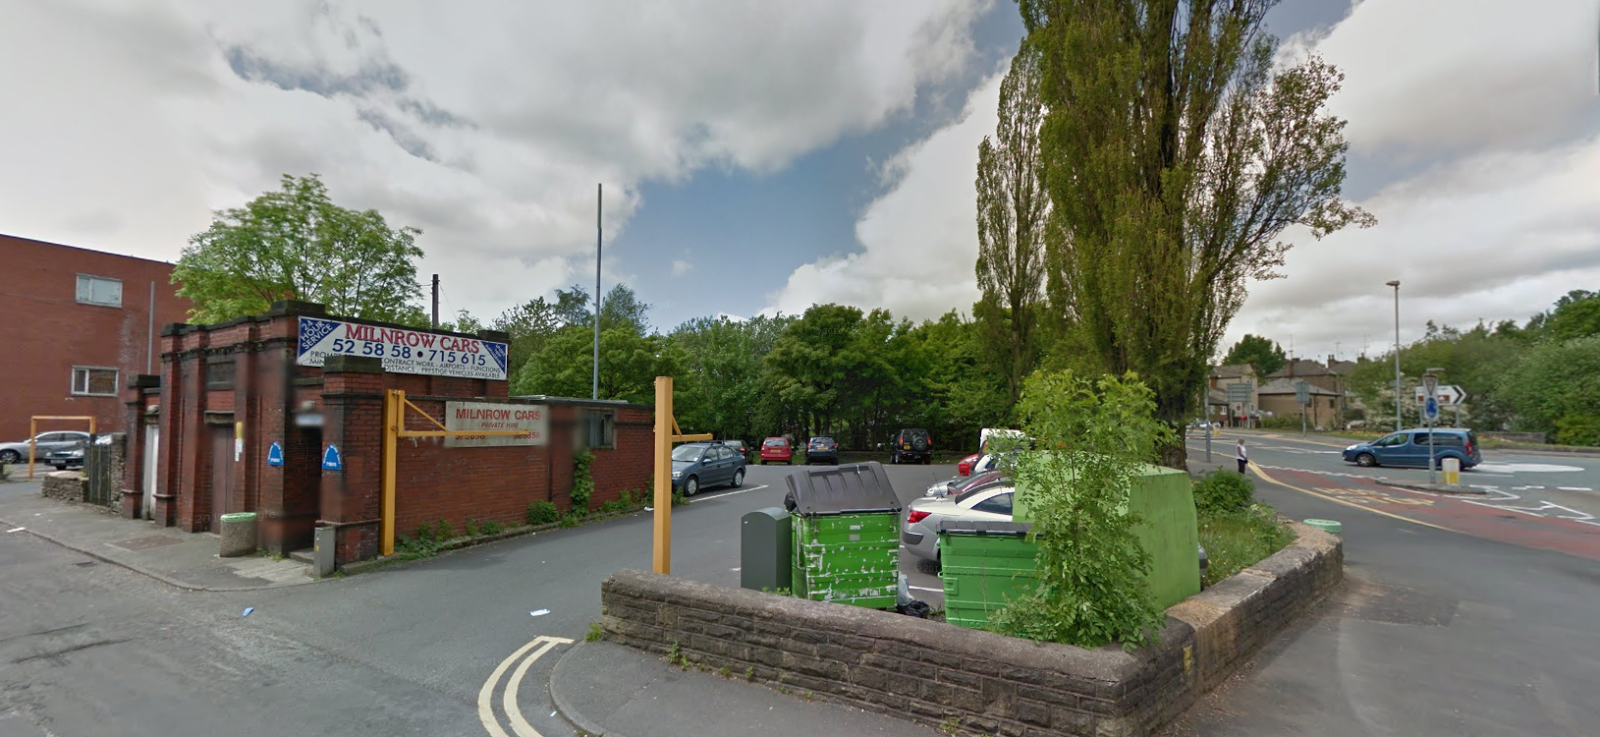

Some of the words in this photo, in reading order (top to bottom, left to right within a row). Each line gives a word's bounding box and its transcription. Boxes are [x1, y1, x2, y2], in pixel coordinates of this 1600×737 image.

[300, 321, 325, 341] HOUR
[301, 320, 314, 330] 24
[301, 323, 333, 350] SERVICE
[345, 323, 437, 348] MILNROW
[439, 335, 480, 354] CARS
[332, 338, 355, 353] 52
[362, 341, 385, 356] 58
[390, 345, 412, 359] 58
[428, 349, 456, 363] 715
[460, 352, 486, 366] 615
[383, 357, 415, 366] ONTRACT
[440, 362, 467, 370] AIRPORTS
[455, 408, 511, 420] MILNROW
[514, 410, 541, 421] CARS
